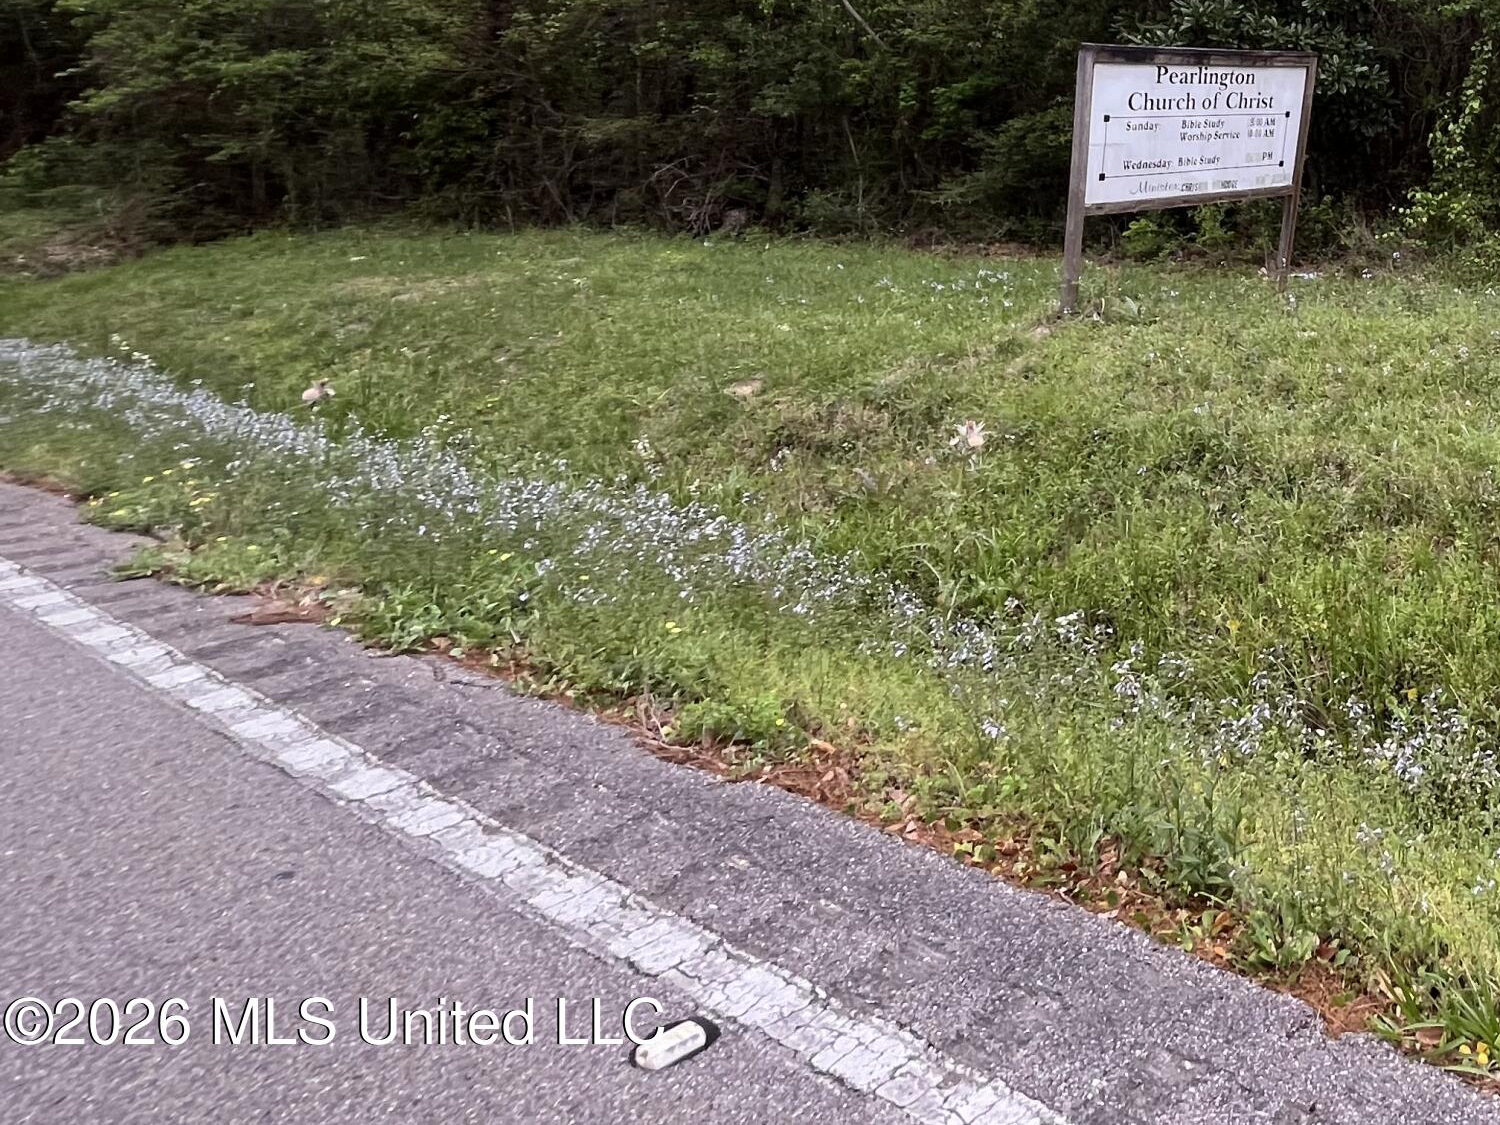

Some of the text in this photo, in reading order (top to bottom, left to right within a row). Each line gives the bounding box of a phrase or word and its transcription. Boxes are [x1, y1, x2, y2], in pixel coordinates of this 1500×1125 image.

[1156, 65, 1256, 91] Pearlington
[1128, 91, 1274, 111] Church of Christ
[1181, 119, 1201, 129] Bible
[1203, 118, 1225, 129] Study
[1264, 117, 1276, 126] AM
[1180, 131, 1213, 142] Worship
[1213, 130, 1240, 140] Service
[1263, 129, 1275, 138] AM
[1178, 157, 1198, 167] Bible
[1199, 155, 1221, 166] Study
[1262, 152, 1273, 161] PM
